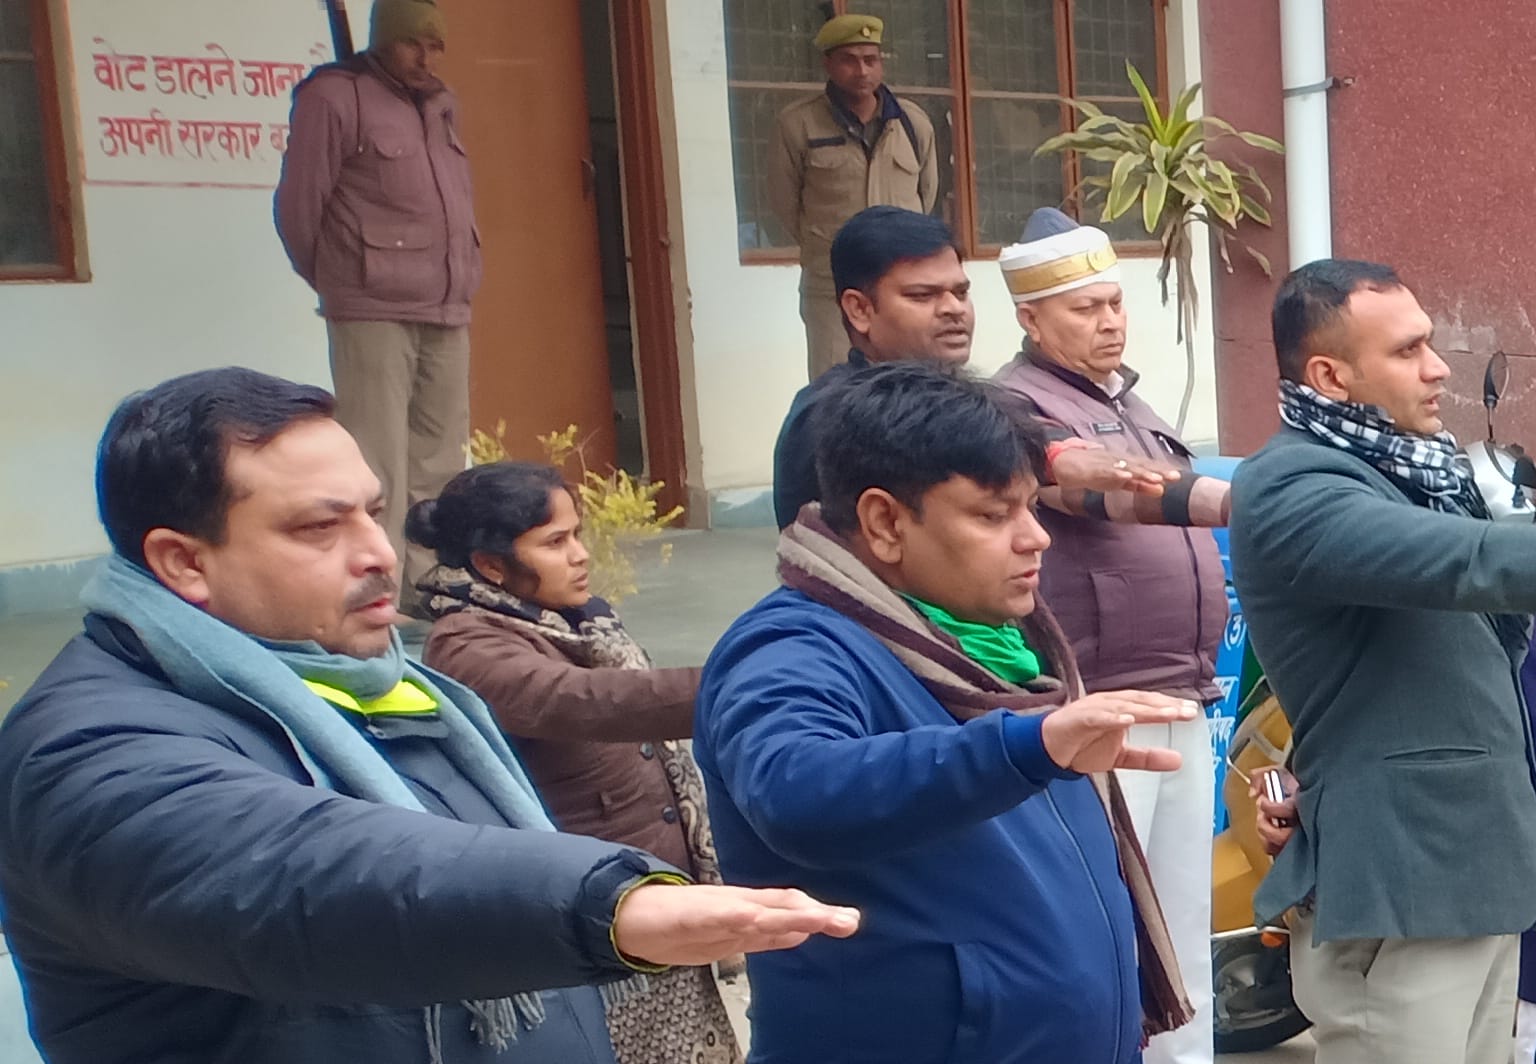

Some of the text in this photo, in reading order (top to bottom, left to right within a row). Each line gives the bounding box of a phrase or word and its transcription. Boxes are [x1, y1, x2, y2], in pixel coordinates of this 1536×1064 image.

[93, 37, 147, 93] वोट
[152, 43, 236, 100] डालने
[99, 108, 174, 157] अपनी
[178, 119, 266, 161] सरकार
